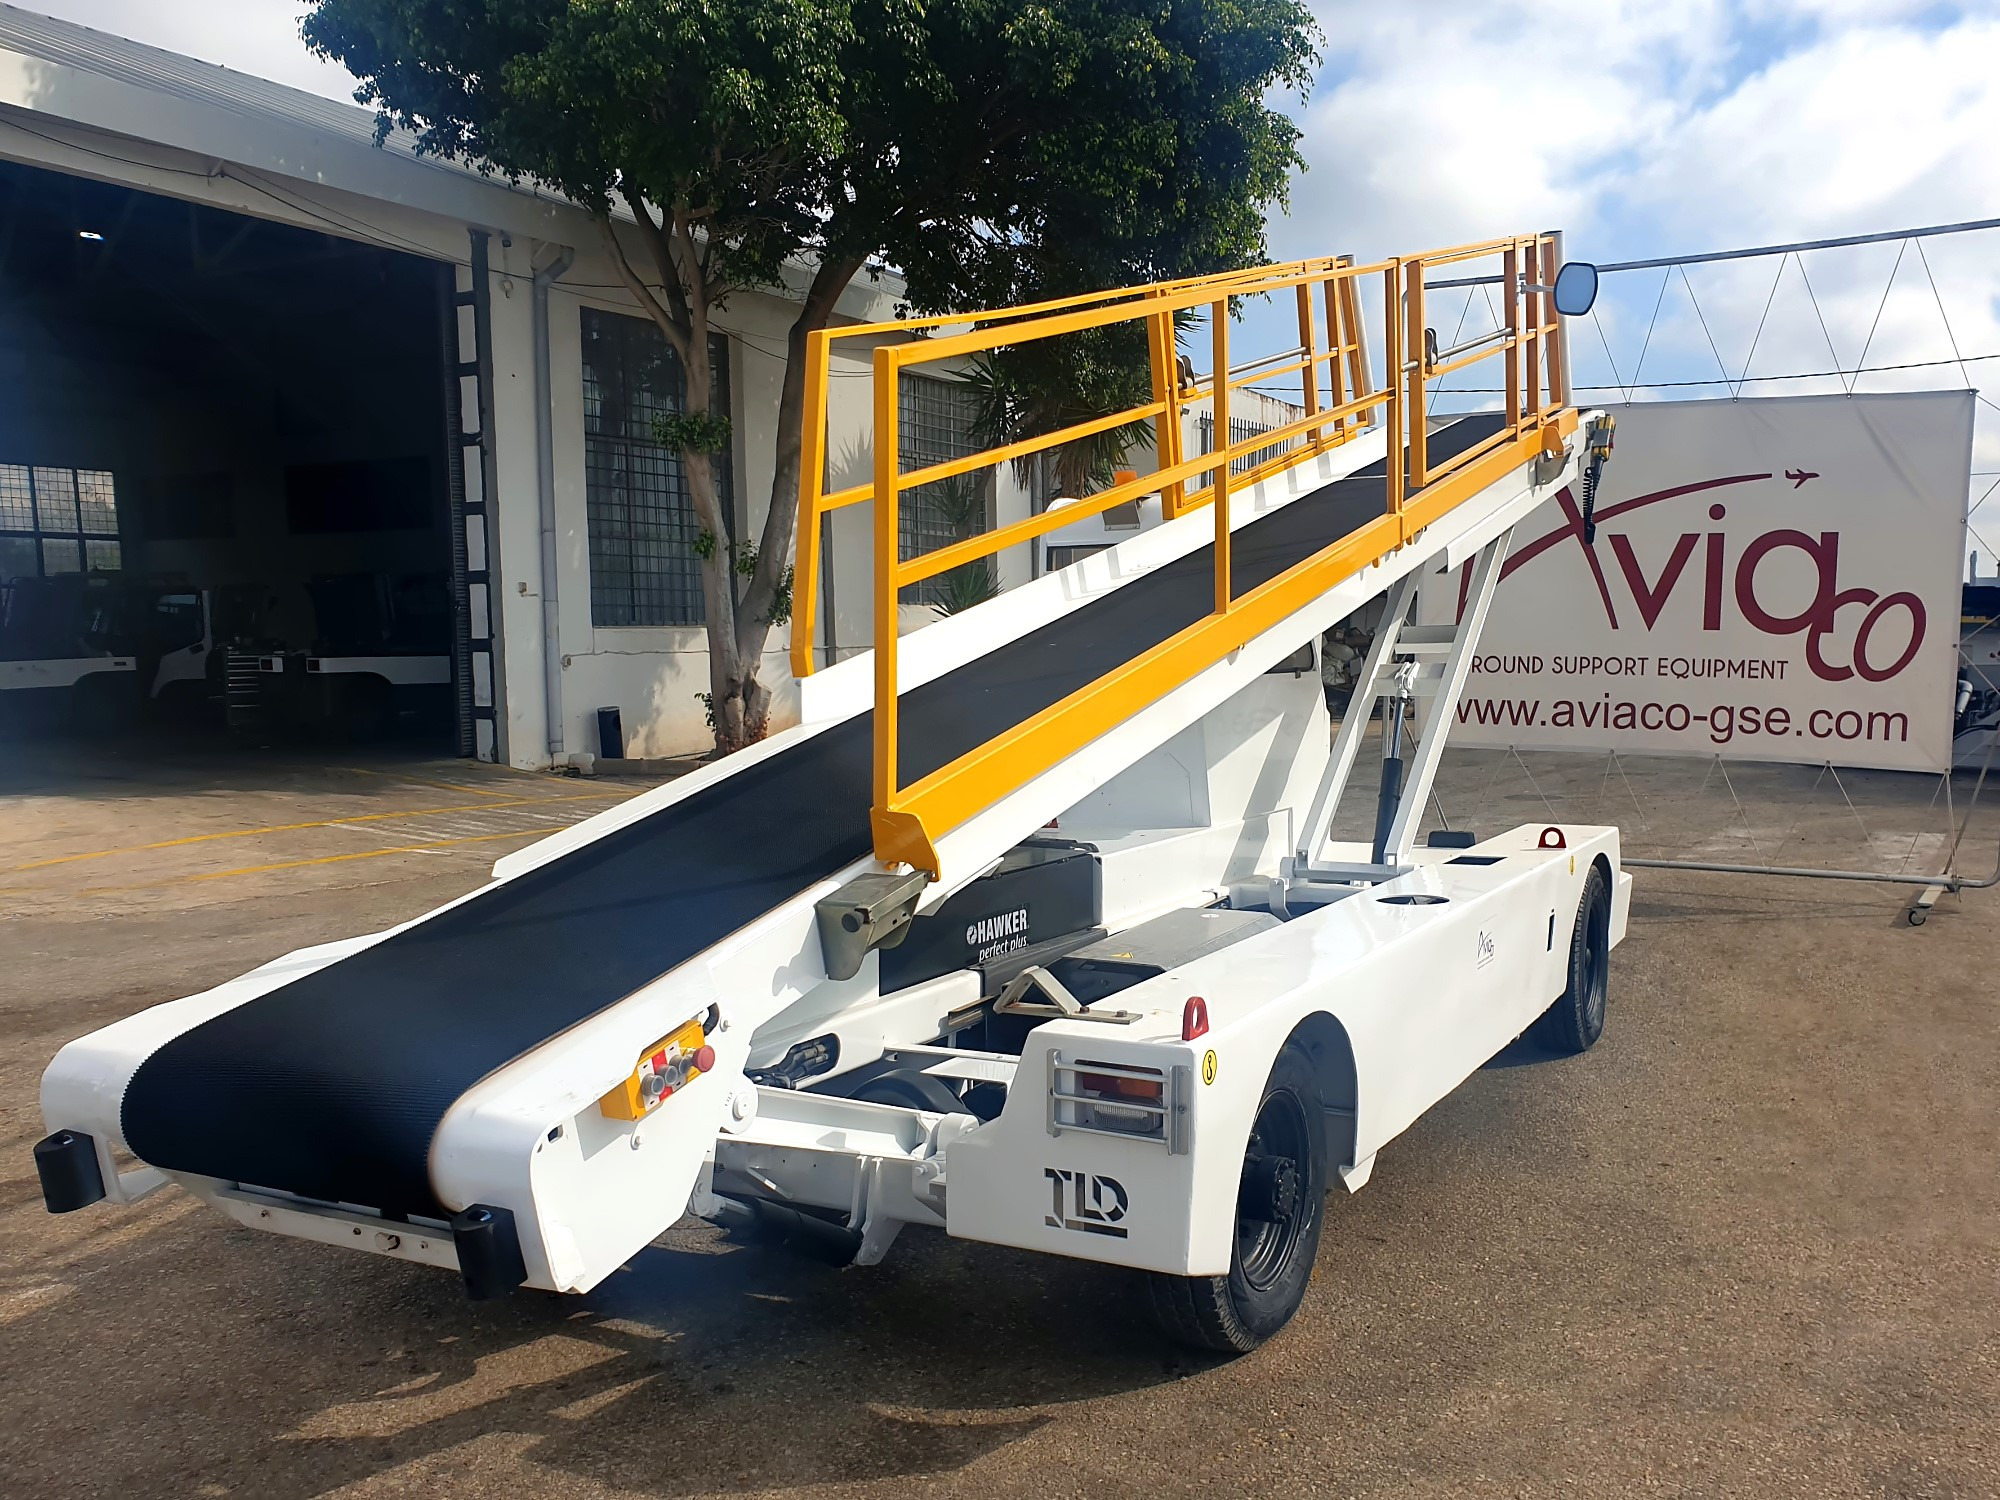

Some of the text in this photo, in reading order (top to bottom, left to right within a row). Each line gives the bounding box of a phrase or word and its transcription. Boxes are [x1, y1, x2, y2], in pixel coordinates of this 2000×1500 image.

[1470, 654, 1790, 680] ROUND SUPPORT EQUIPMENT
[978, 909, 1027, 944] HAWKER
[978, 934, 1028, 963] perfect plus
[1043, 1167, 1129, 1226] TLD
